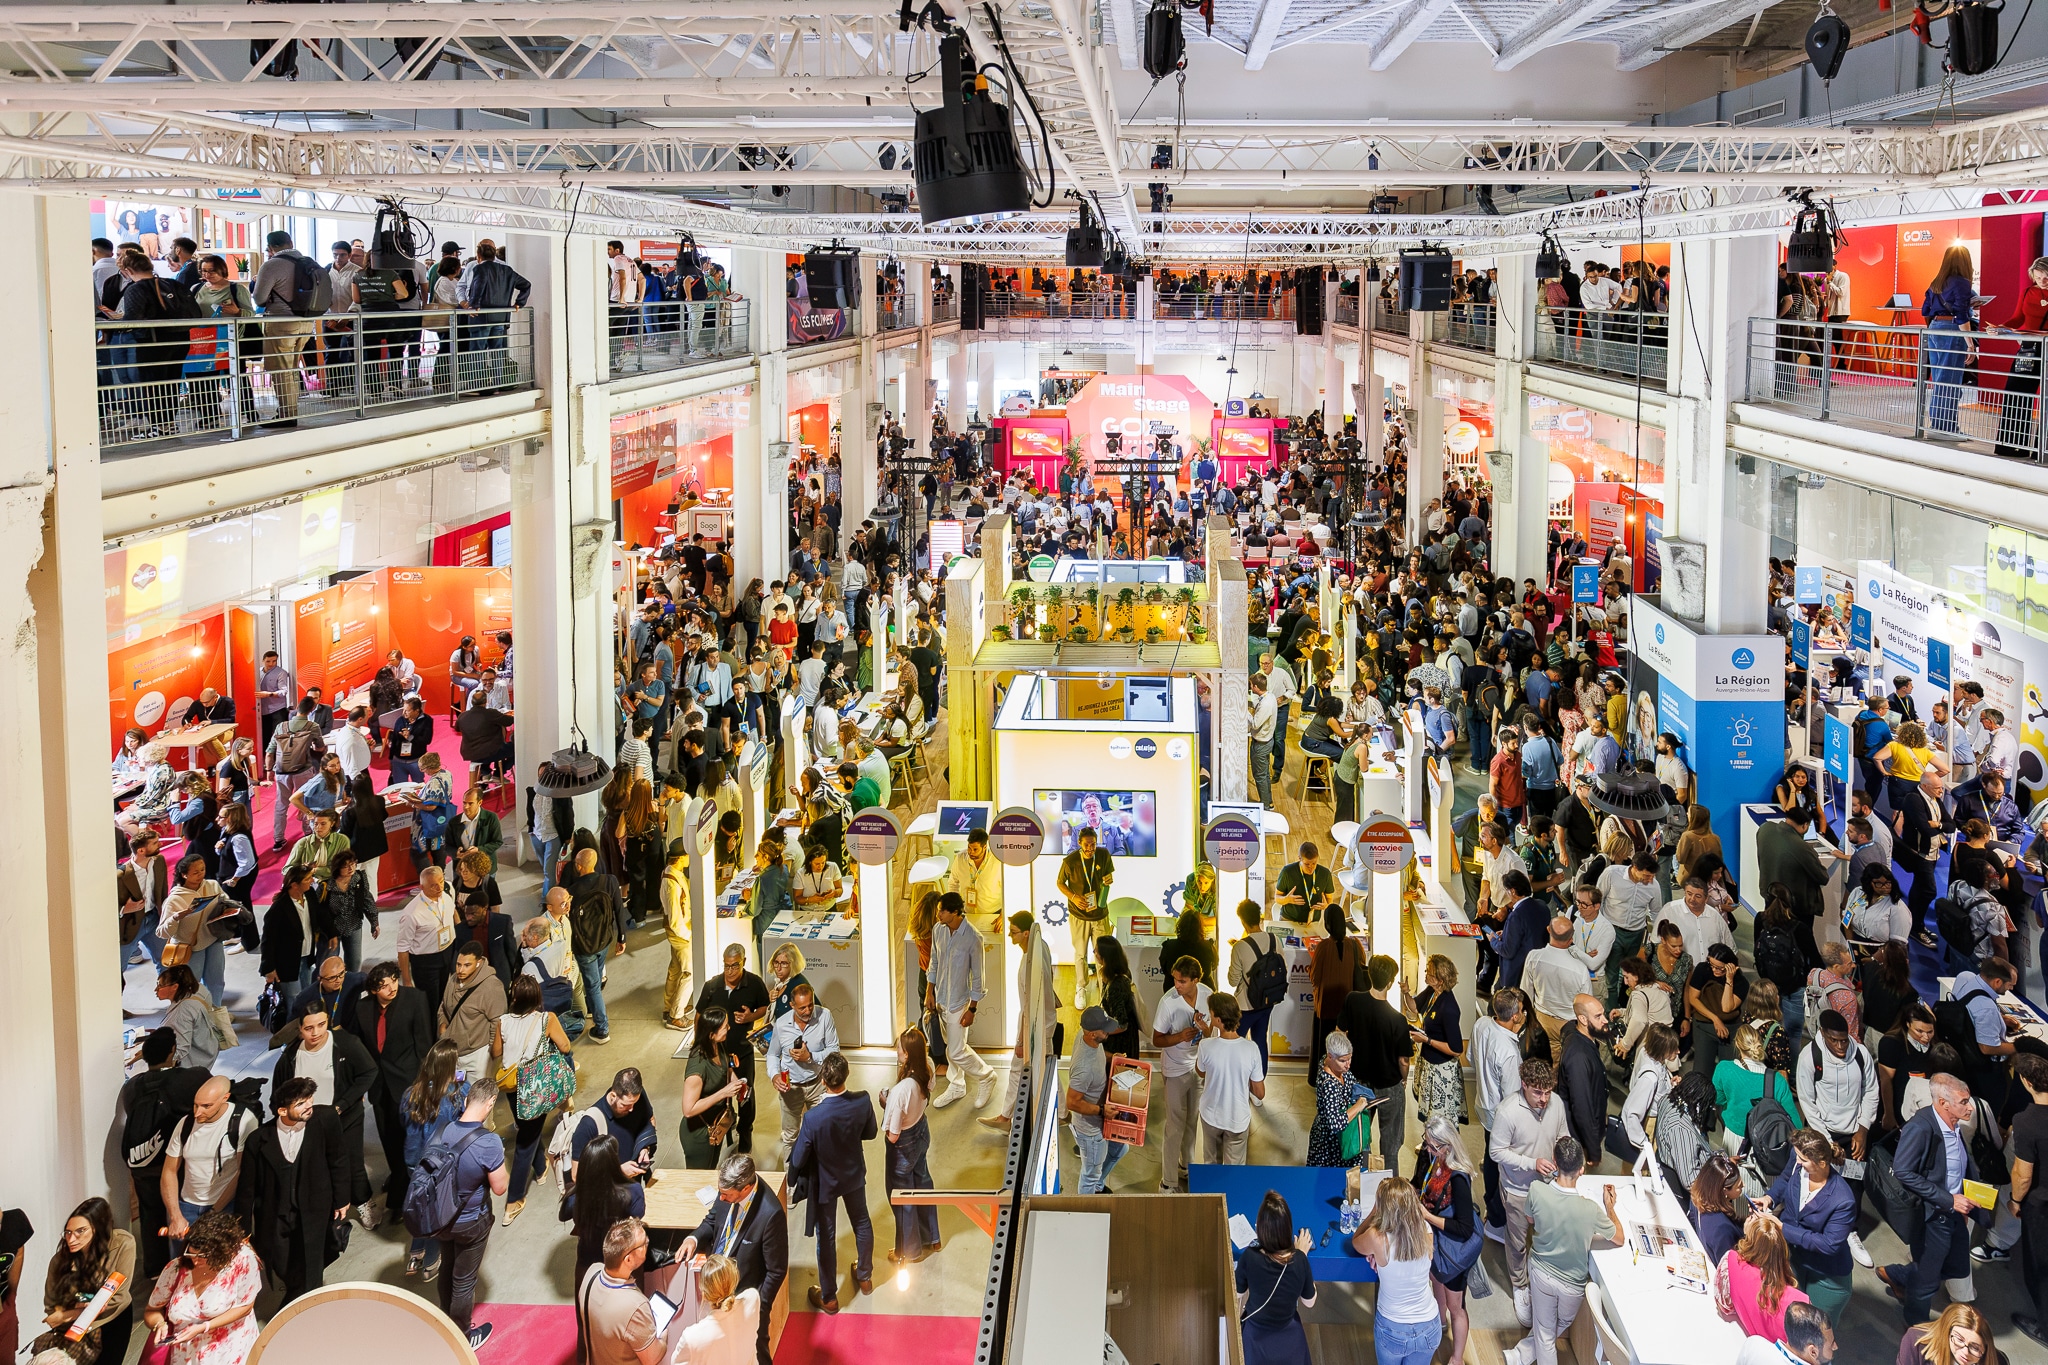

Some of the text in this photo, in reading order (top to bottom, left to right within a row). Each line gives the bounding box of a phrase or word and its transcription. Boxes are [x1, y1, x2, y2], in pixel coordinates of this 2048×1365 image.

[630, 264, 636, 282] 10
[800, 315, 810, 328] LES
[1100, 383, 1146, 398] Main
[1134, 398, 1190, 414] Stage
[700, 522, 718, 532] Sage
[1882, 584, 1929, 614] La Région
[1881, 616, 1918, 641] Financeurs
[1888, 632, 1896, 643] de
[1898, 636, 1904, 647] la
[1954, 652, 1970, 667] tion
[138, 679, 152, 688] Vous
[1715, 675, 1770, 686] La Région
[1078, 702, 1100, 712] REJOIGNEZ
[1221, 847, 1249, 856] pépite
[130, 1130, 161, 1163] NIKE
